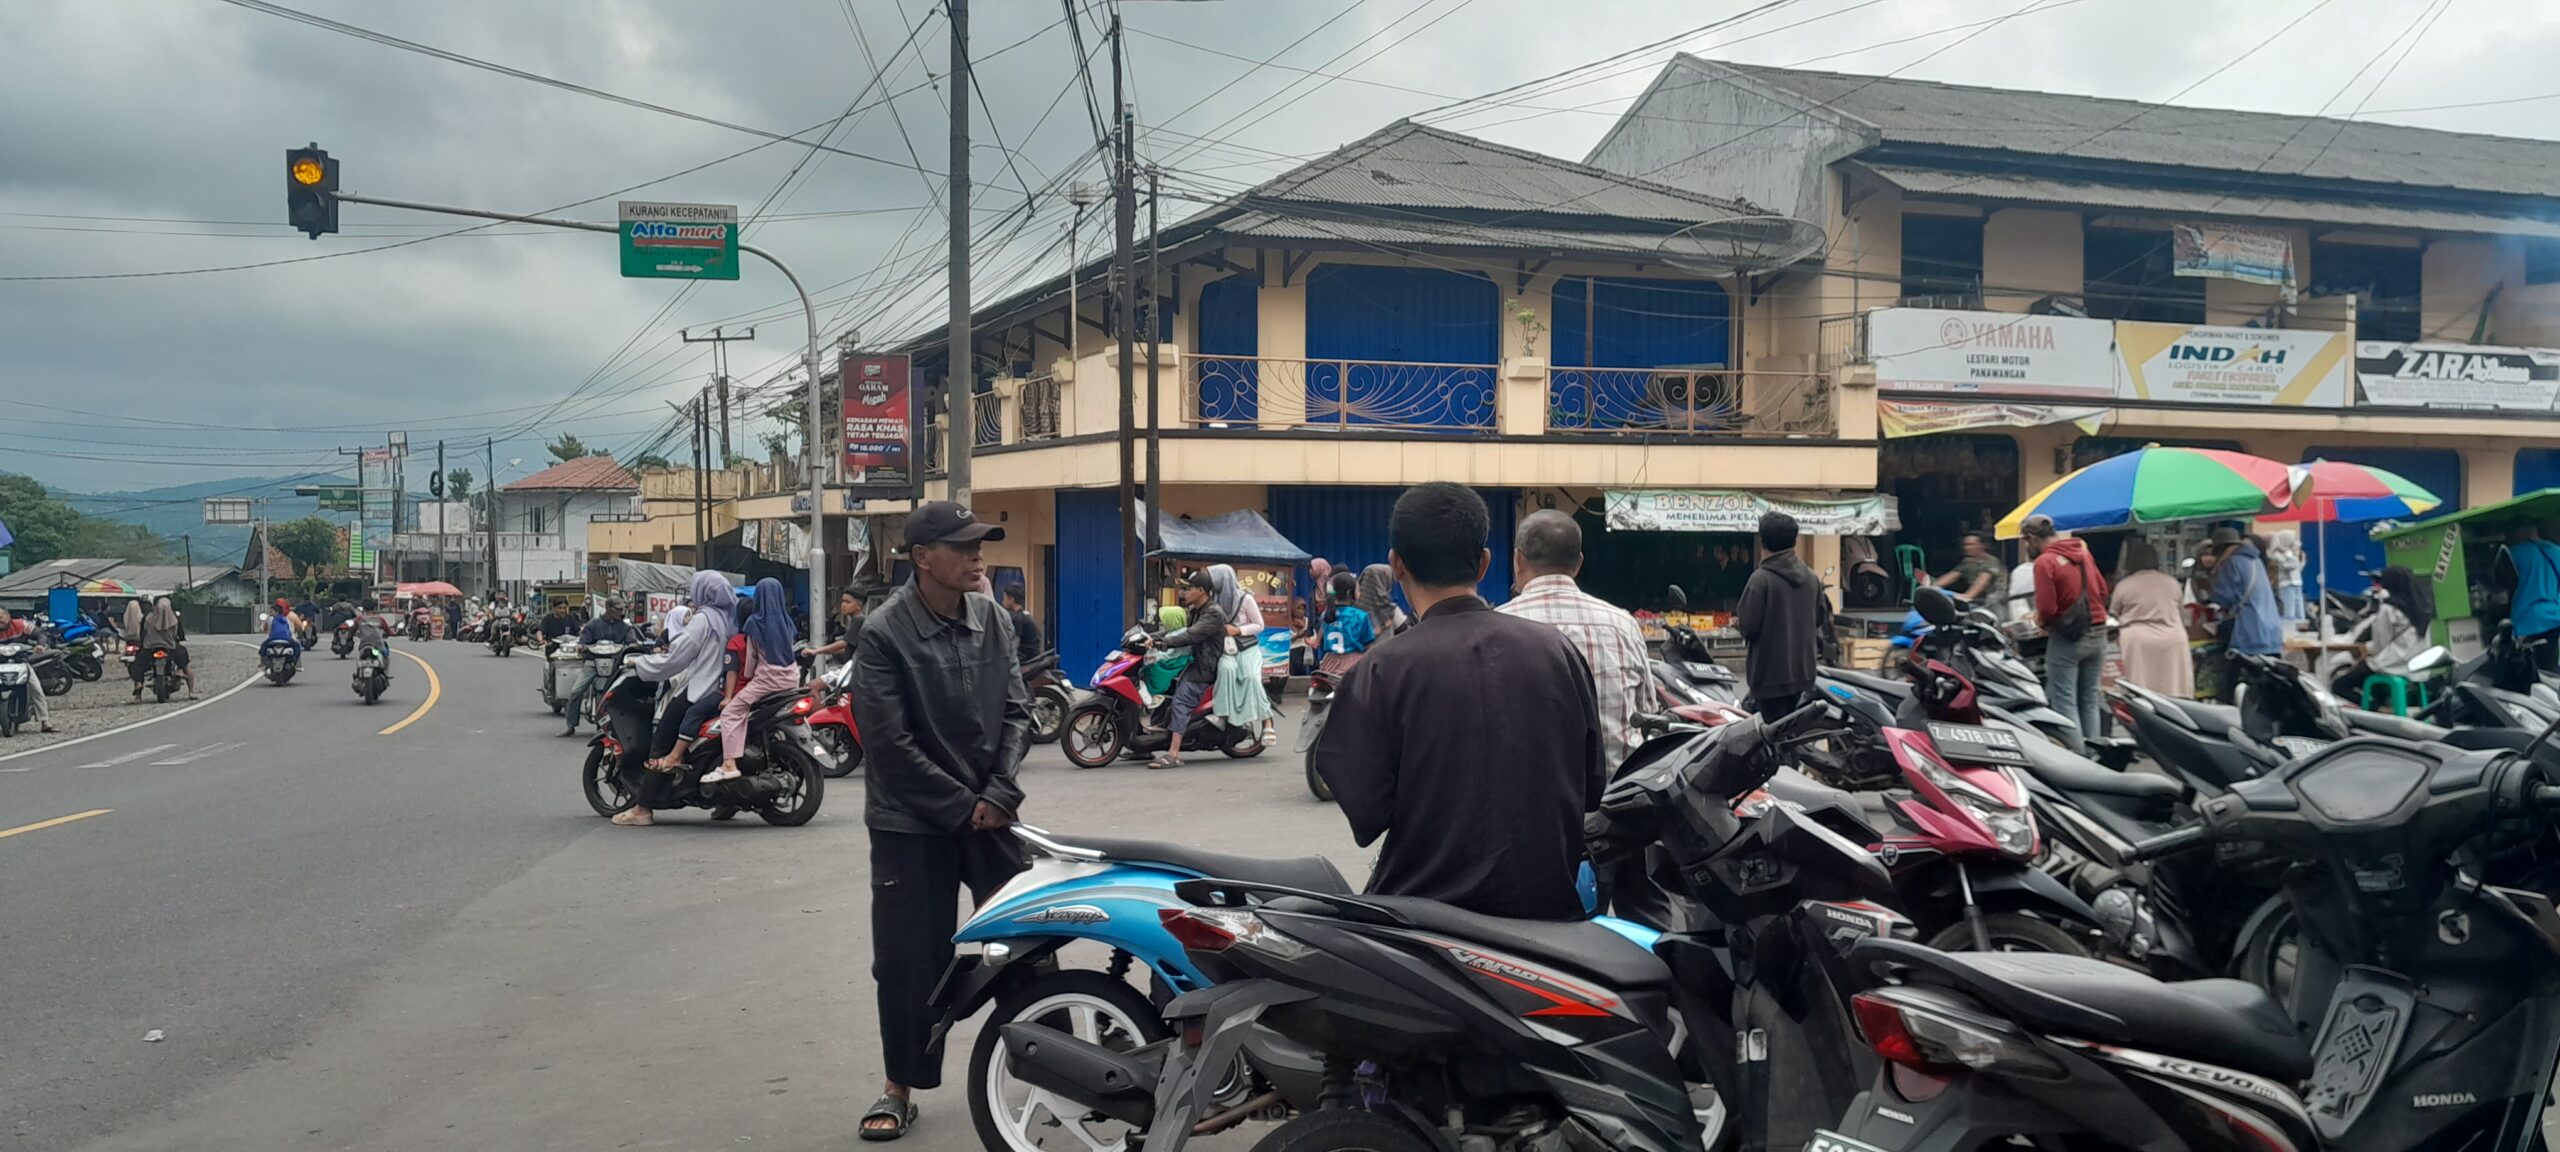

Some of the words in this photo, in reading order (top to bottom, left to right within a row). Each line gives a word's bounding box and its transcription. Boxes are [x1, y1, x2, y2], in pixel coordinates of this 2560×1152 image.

[629, 206, 669, 217] KURANGI
[631, 222, 727, 239] Alfamart
[1972, 322, 2055, 350] YAMAHA
[1966, 354, 1999, 364] LESTARI
[2001, 356, 2030, 366] MOTOR
[2168, 362, 2220, 371] LOGISTIK
[2237, 365, 2284, 373] CARGO
[2394, 352, 2485, 380] ZARA
[1969, 368, 2026, 379] PANAWANGAN
[1655, 494, 1756, 512] BENZOE
[1666, 513, 1727, 521] MENERIMA
[1257, 571, 1281, 588] OYE
[1932, 726, 1944, 740] Z
[1987, 731, 2017, 748] TAE
[1826, 909, 1874, 929] HONDA
[2413, 1092, 2476, 1108] HONDA
